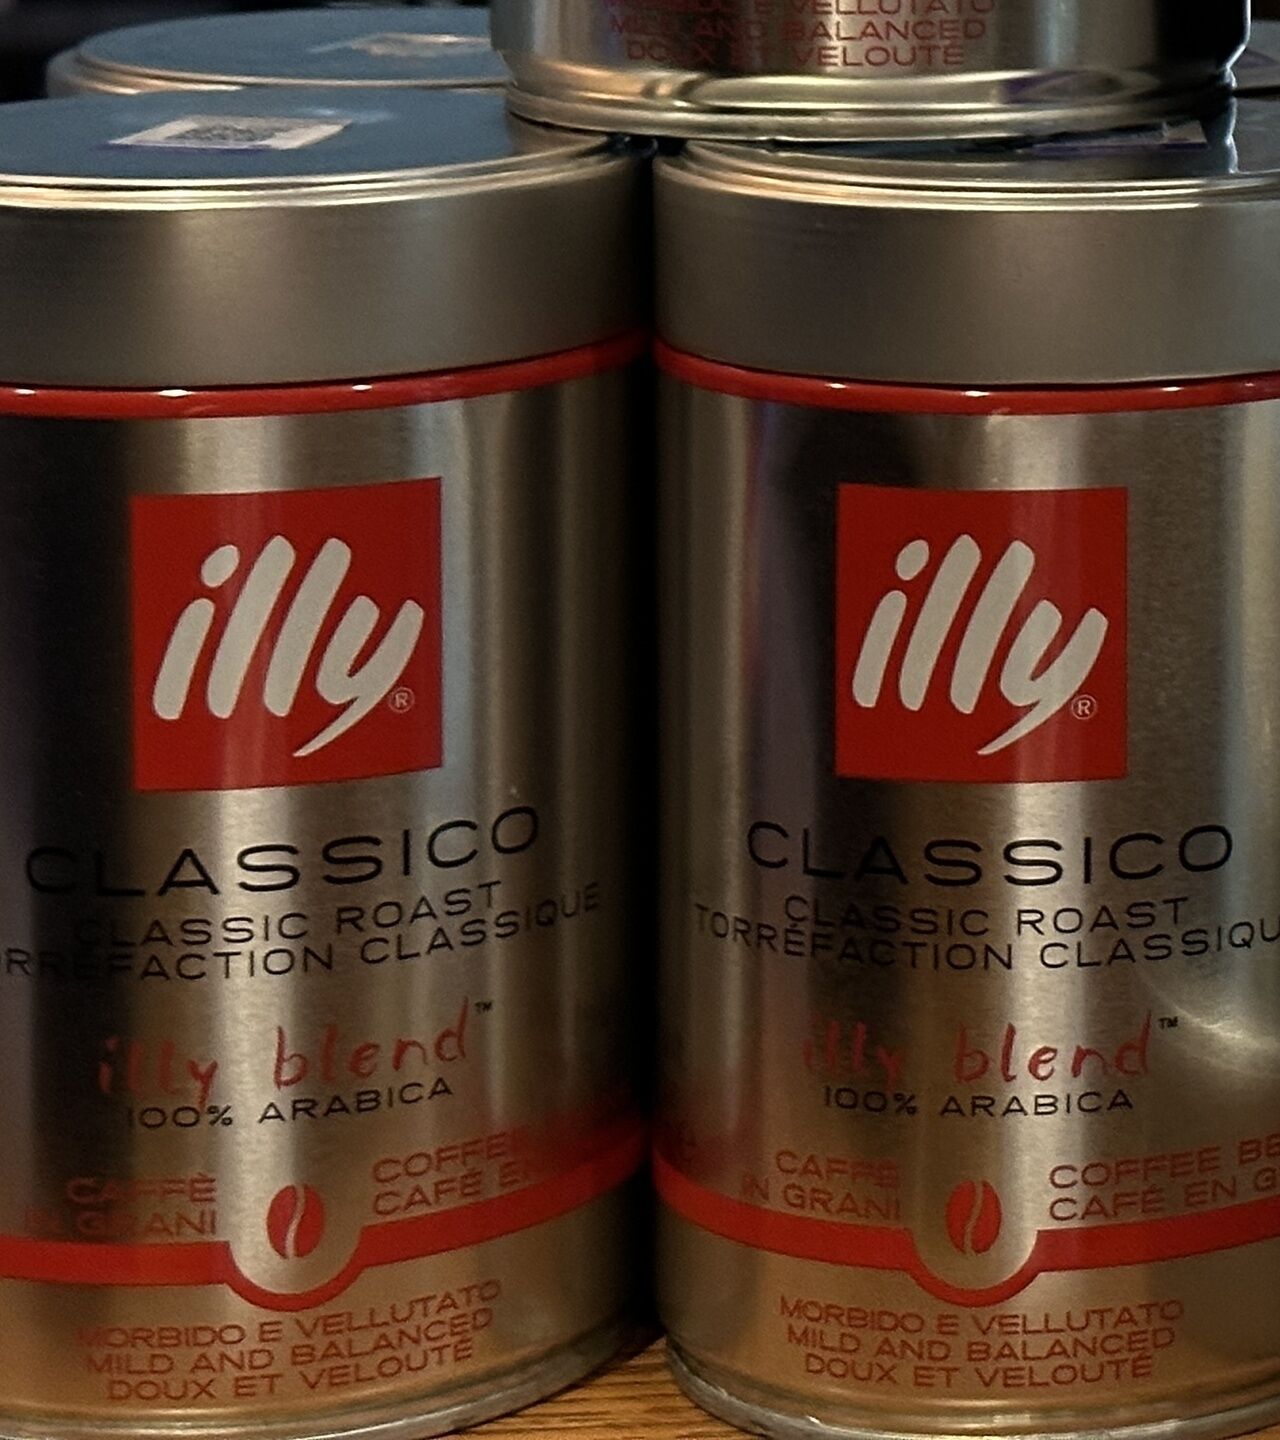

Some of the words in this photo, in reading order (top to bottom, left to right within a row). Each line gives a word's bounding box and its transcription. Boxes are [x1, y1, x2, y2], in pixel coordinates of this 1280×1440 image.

[782, 17, 987, 42] BALANCED
[151, 534, 425, 758] illy
[850, 533, 1110, 756] illy
[25, 805, 539, 897] CLASSICO
[746, 820, 1233, 887] CLASSICO
[334, 880, 502, 935] ROAST
[360, 881, 602, 965] CLASSIQUE
[784, 893, 990, 936] CLASSIC
[1016, 895, 1190, 936] ROAST
[274, 994, 470, 1090] blend
[954, 1008, 1152, 1084] blend
[130, 1103, 233, 1131] 100%
[258, 1075, 454, 1125] ARABICA
[823, 1085, 919, 1117] 100%
[939, 1088, 1135, 1118] ARABICA
[372, 1166, 483, 1216] CAFÉ
[1049, 1145, 1222, 1190] COFFEE
[782, 1182, 900, 1221] GRANI
[1048, 1183, 1167, 1222] CAFÉ
[1183, 1176, 1238, 1210] EN
[77, 1323, 246, 1349] MORBIDO
[258, 1319, 283, 1344] E
[293, 1279, 502, 1339] VELLUTATO
[780, 1293, 926, 1334] MORBIDO
[936, 1312, 961, 1336] E
[969, 1298, 1186, 1336] VELLUTATO
[87, 1351, 174, 1376] MILD
[189, 1348, 275, 1375] AND
[289, 1306, 494, 1365] BALANCED
[786, 1321, 862, 1355] MILD
[872, 1336, 953, 1362] AND
[966, 1325, 1177, 1363] BALANCED
[107, 1377, 217, 1402] DOUX
[233, 1372, 283, 1398] ET
[804, 1351, 901, 1386] DOUX
[913, 1364, 961, 1390] ET
